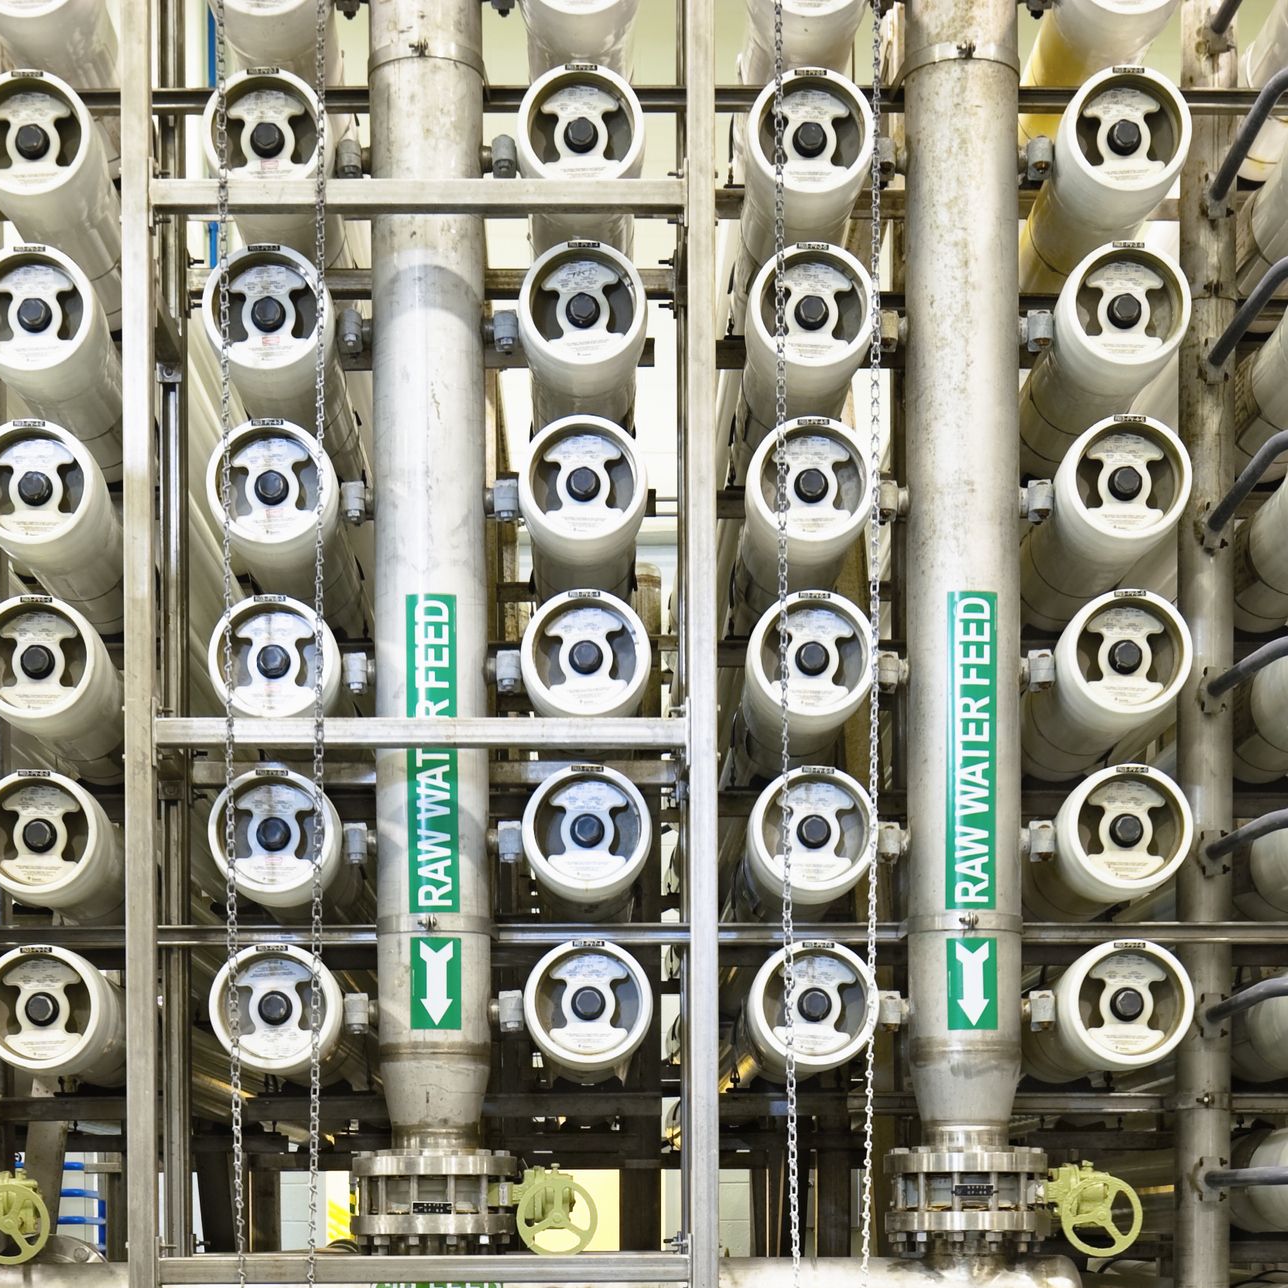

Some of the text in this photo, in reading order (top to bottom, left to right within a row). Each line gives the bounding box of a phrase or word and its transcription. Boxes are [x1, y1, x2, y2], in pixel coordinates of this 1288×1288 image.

[414, 599, 454, 907] RAW WATR FEED
[953, 597, 992, 904] RAW WATER FEED
